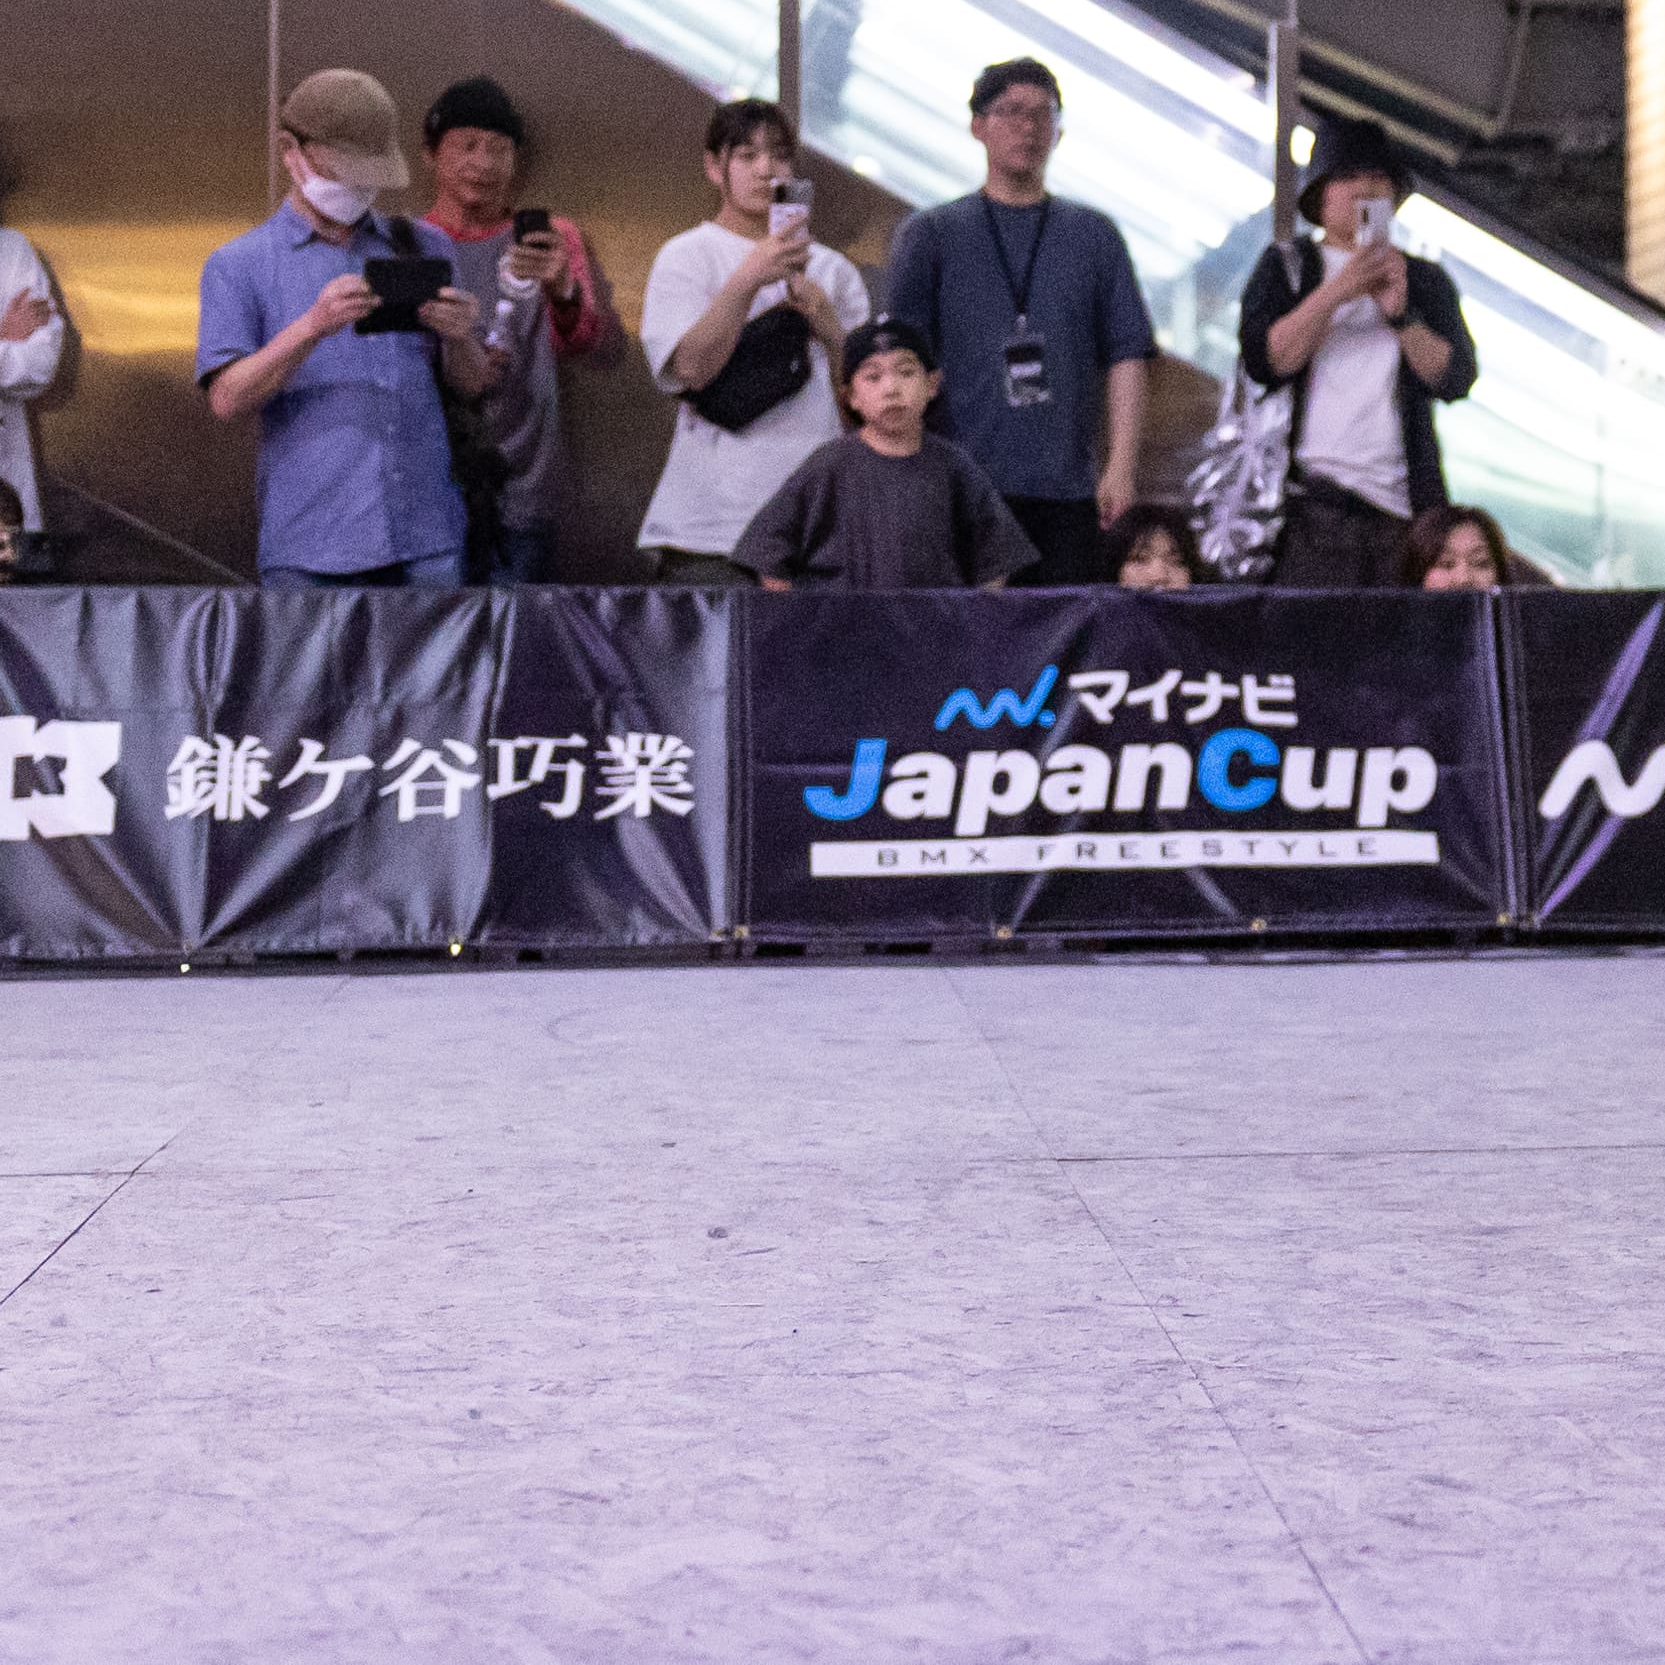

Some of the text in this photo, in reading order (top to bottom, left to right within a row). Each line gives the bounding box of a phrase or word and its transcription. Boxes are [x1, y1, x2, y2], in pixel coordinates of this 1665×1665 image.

[1069, 669, 1298, 725] マイナビ
[802, 727, 1438, 836] JapanCup
[877, 837, 1378, 867] BMX FREESTYLE
